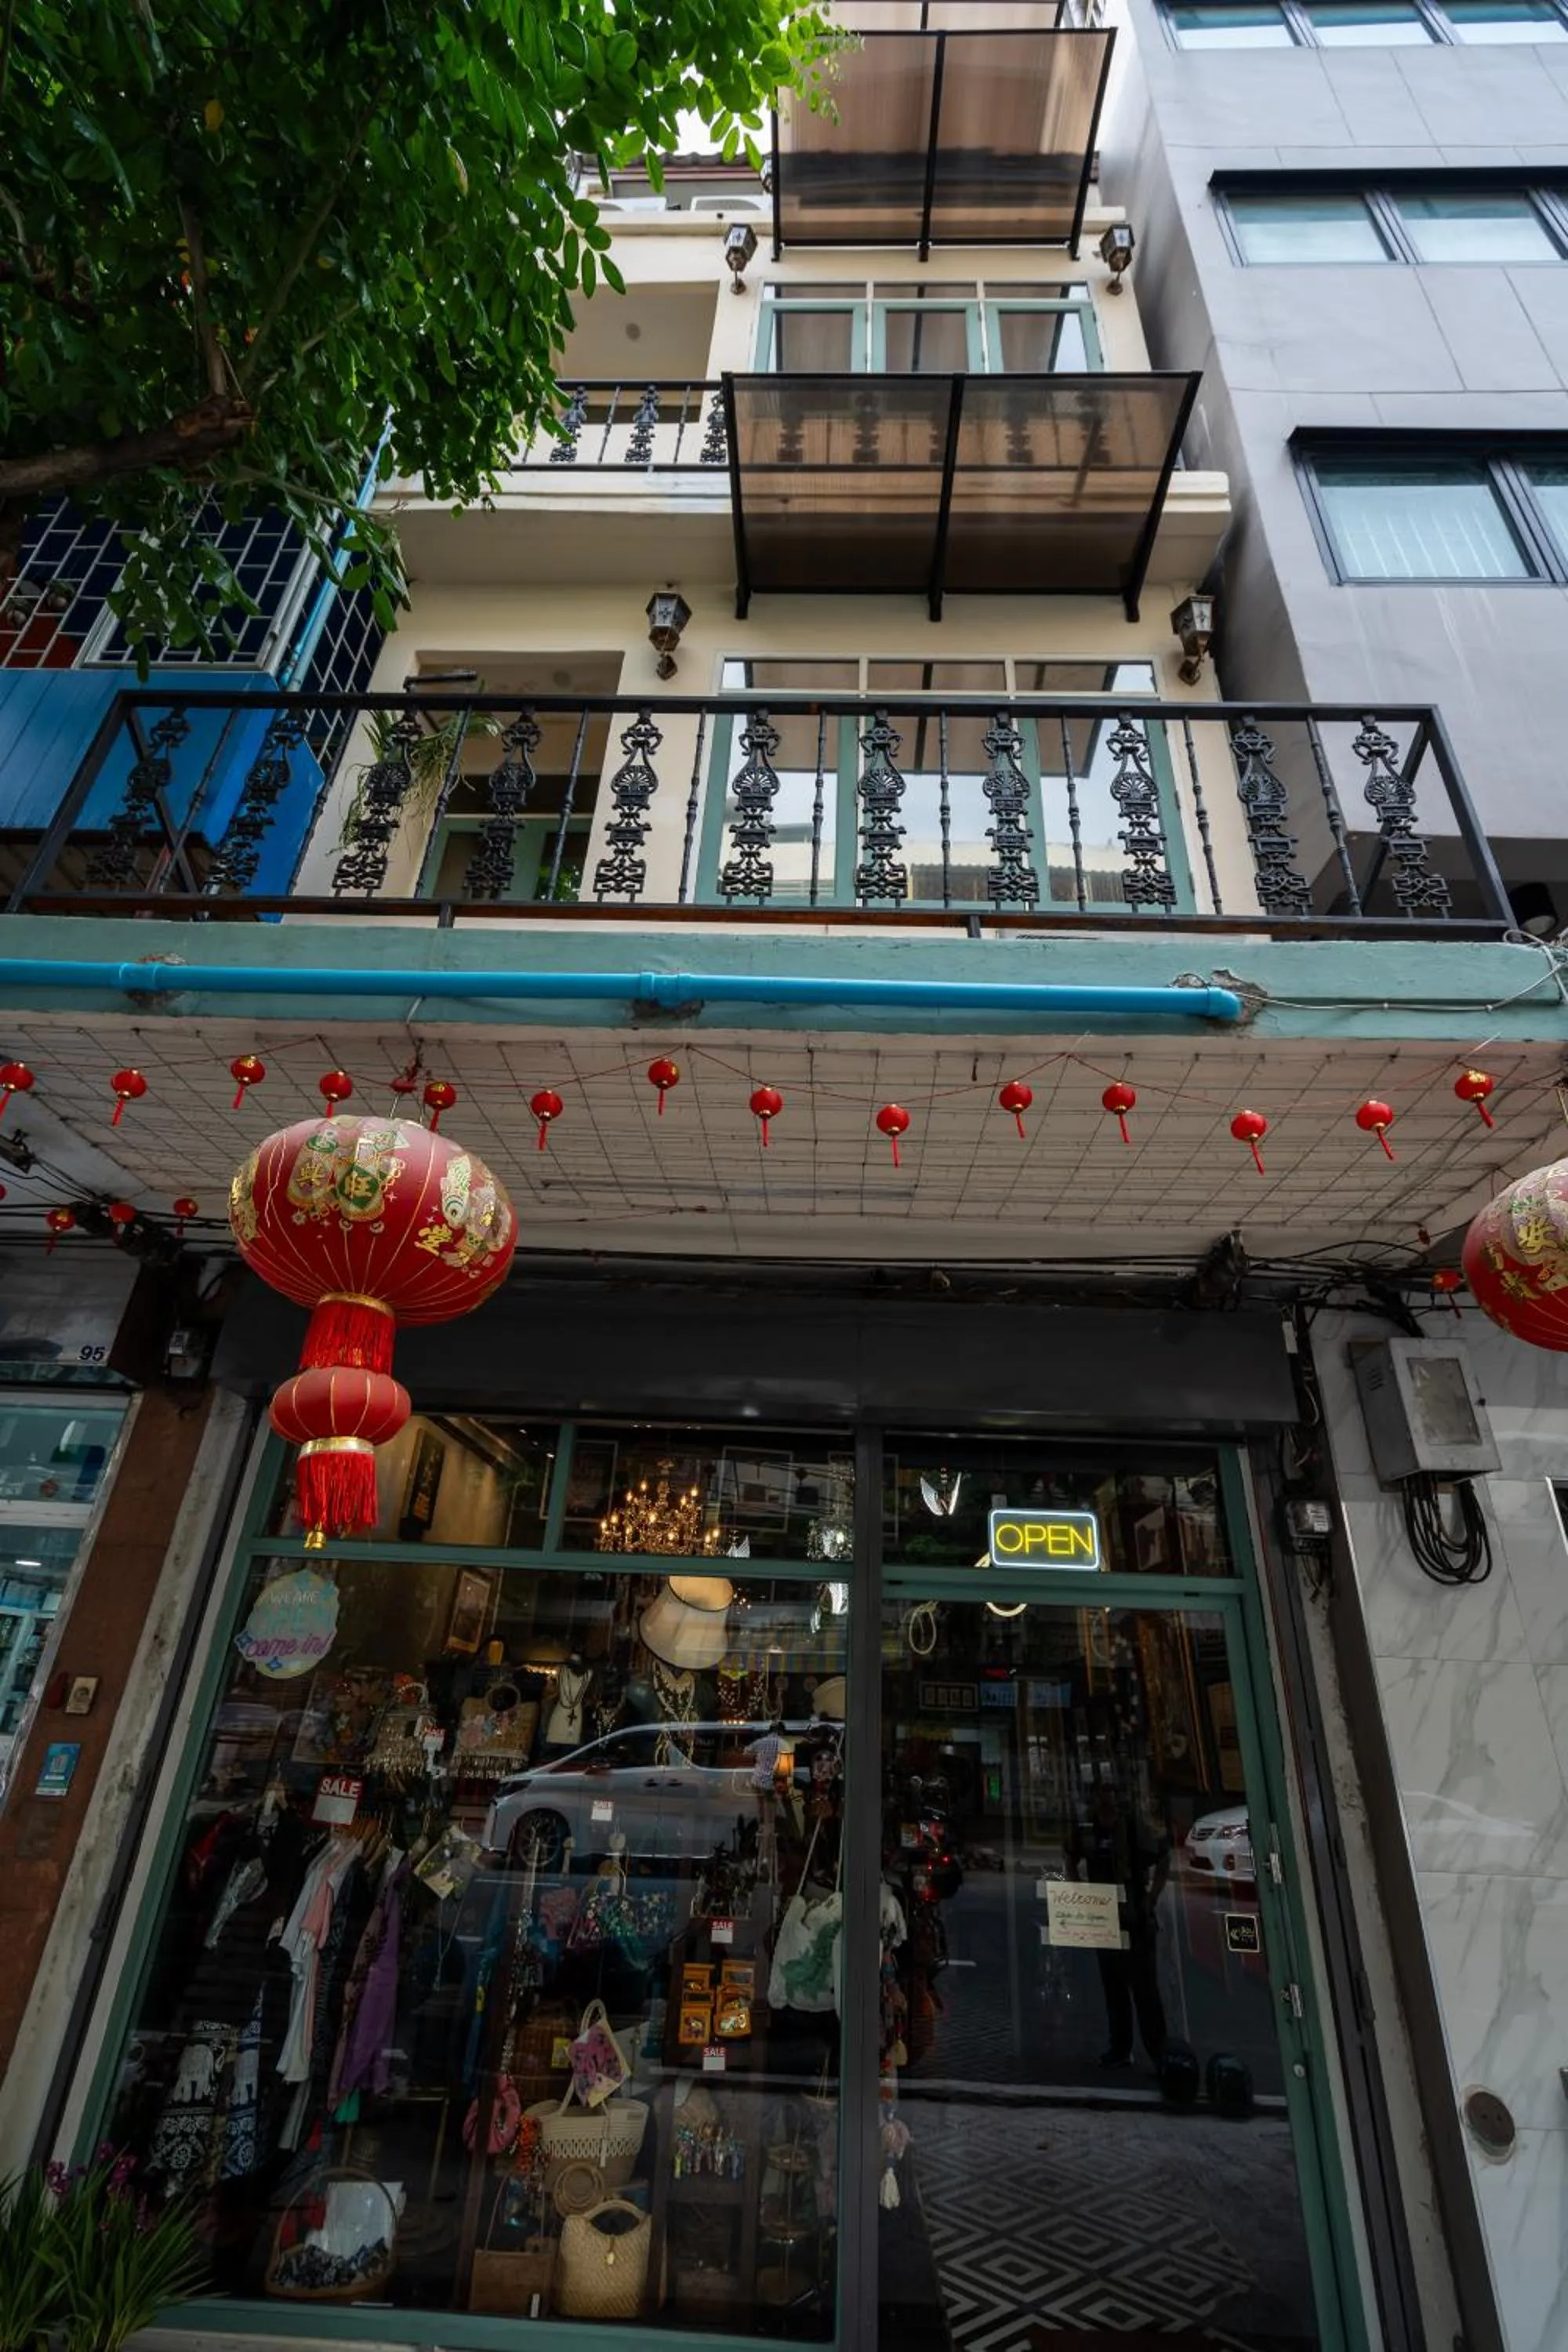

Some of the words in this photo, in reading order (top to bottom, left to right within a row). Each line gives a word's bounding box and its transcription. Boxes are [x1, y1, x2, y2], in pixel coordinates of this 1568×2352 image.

[79, 1345, 105, 1361] 95
[996, 1523, 1094, 1555] OPEN
[320, 1777, 362, 1798] SALE
[712, 1920, 734, 1931] SALE
[703, 2046, 725, 2056] SALE
